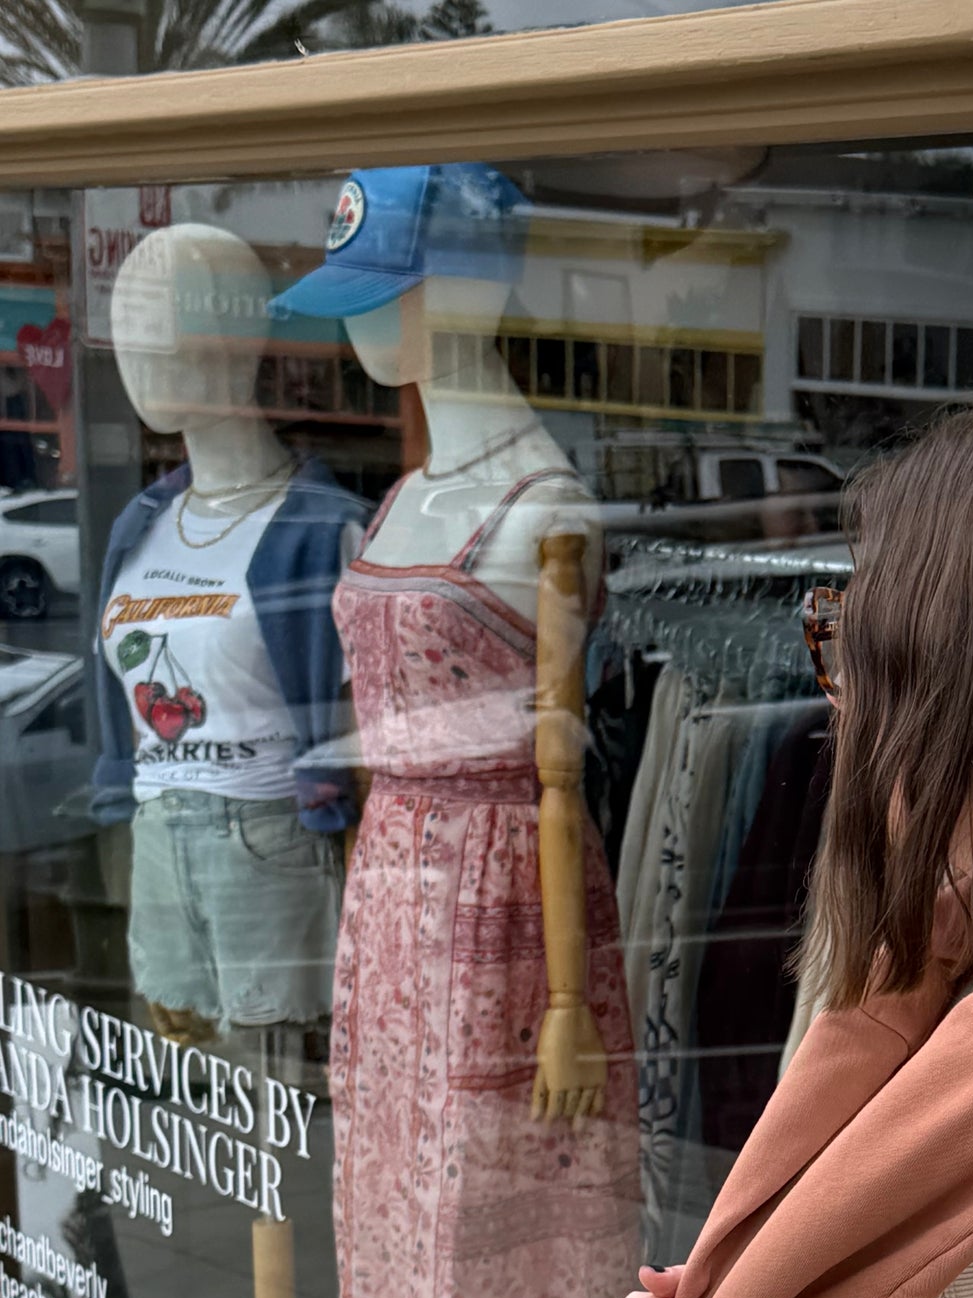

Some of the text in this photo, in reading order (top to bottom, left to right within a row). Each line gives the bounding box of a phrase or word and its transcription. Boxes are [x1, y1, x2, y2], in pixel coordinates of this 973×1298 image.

[103, 593, 240, 639] CALIFORNIA
[80, 1005, 253, 1134] SERVICES
[265, 1076, 317, 1159] BY
[81, 1075, 285, 1221] HOLSINGER
